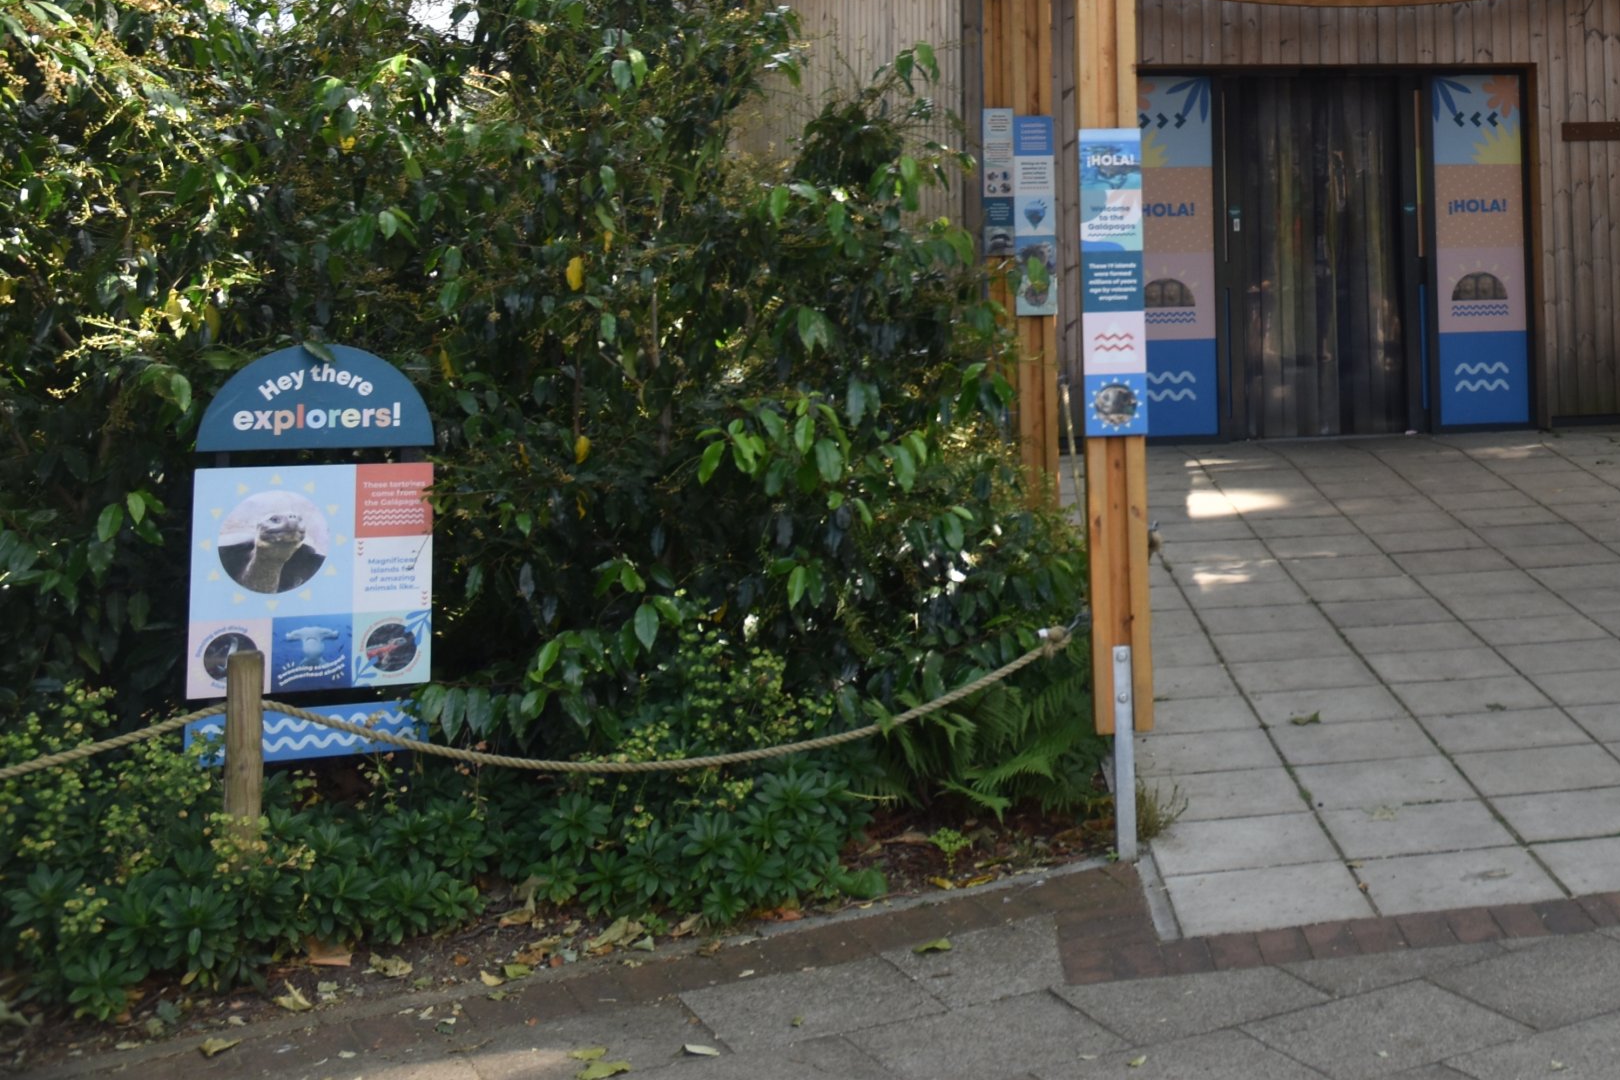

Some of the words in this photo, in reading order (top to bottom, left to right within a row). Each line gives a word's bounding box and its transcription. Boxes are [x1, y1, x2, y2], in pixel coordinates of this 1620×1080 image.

[1087, 154, 1134, 167] ¡HOLA!
[1448, 199, 1507, 215] ¡HOLA!
[1088, 222, 1136, 233] Galápagos
[258, 368, 305, 401] Hey
[310, 363, 373, 397] there
[233, 402, 401, 436] explorers!
[363, 481, 388, 489] These
[389, 480, 426, 488] tortoises
[364, 498, 379, 506] the
[370, 565, 399, 574] islands
[369, 575, 378, 583] of
[380, 574, 416, 583] amazing
[364, 583, 397, 592] animals
